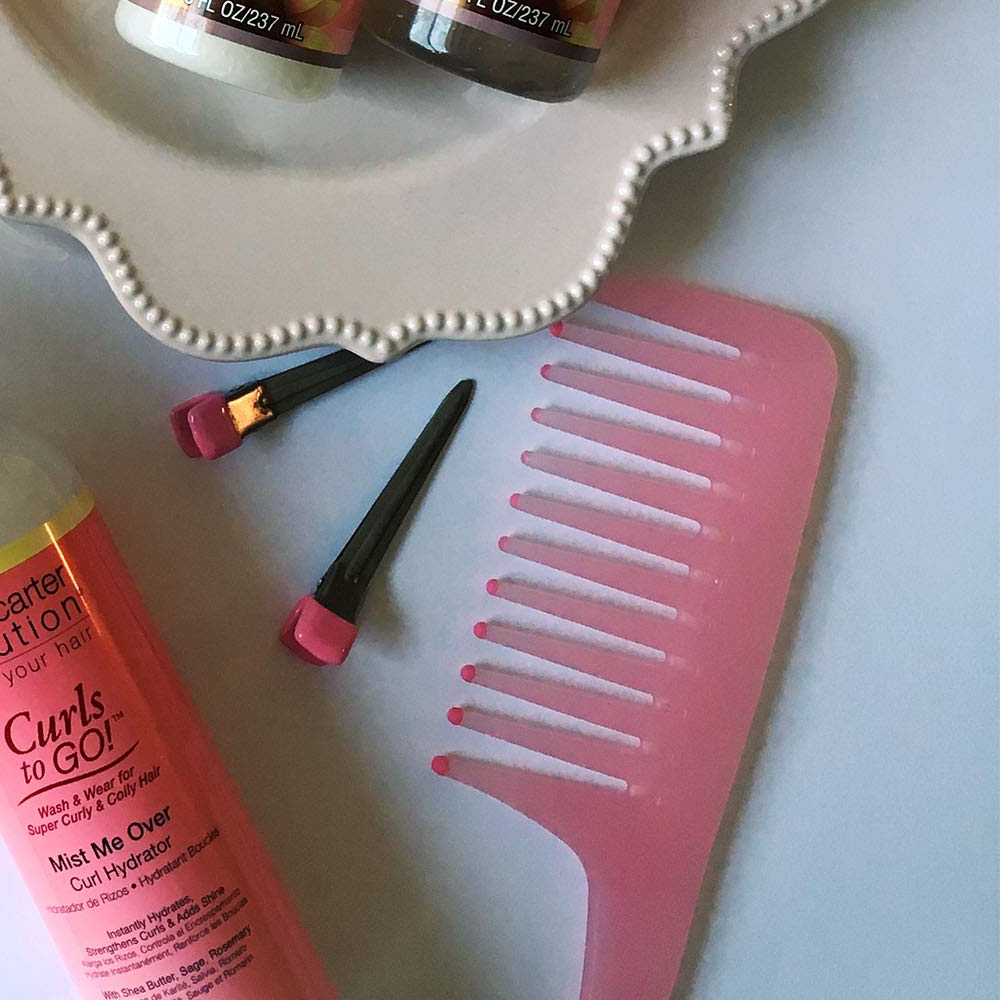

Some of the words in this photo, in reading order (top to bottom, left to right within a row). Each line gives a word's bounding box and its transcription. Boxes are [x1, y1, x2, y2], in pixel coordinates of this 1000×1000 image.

[220, 0, 280, 31] OZ/237
[280, 22, 302, 40] mL
[549, 18, 571, 36] mL
[3, 682, 104, 755] Curls
[19, 759, 46, 784] to
[37, 798, 70, 819] Wash
[72, 793, 82, 807] &
[82, 777, 115, 801] Wear
[116, 765, 135, 784] for
[26, 819, 59, 836] Super
[60, 805, 93, 827] Curly
[95, 798, 105, 812] &
[137, 765, 160, 789] Hair
[47, 848, 91, 873] Mist
[89, 835, 124, 860] Me
[126, 805, 171, 841] Over
[69, 869, 103, 892] Curl
[102, 835, 171, 881] Hydrator
[105, 918, 146, 940] Instantly
